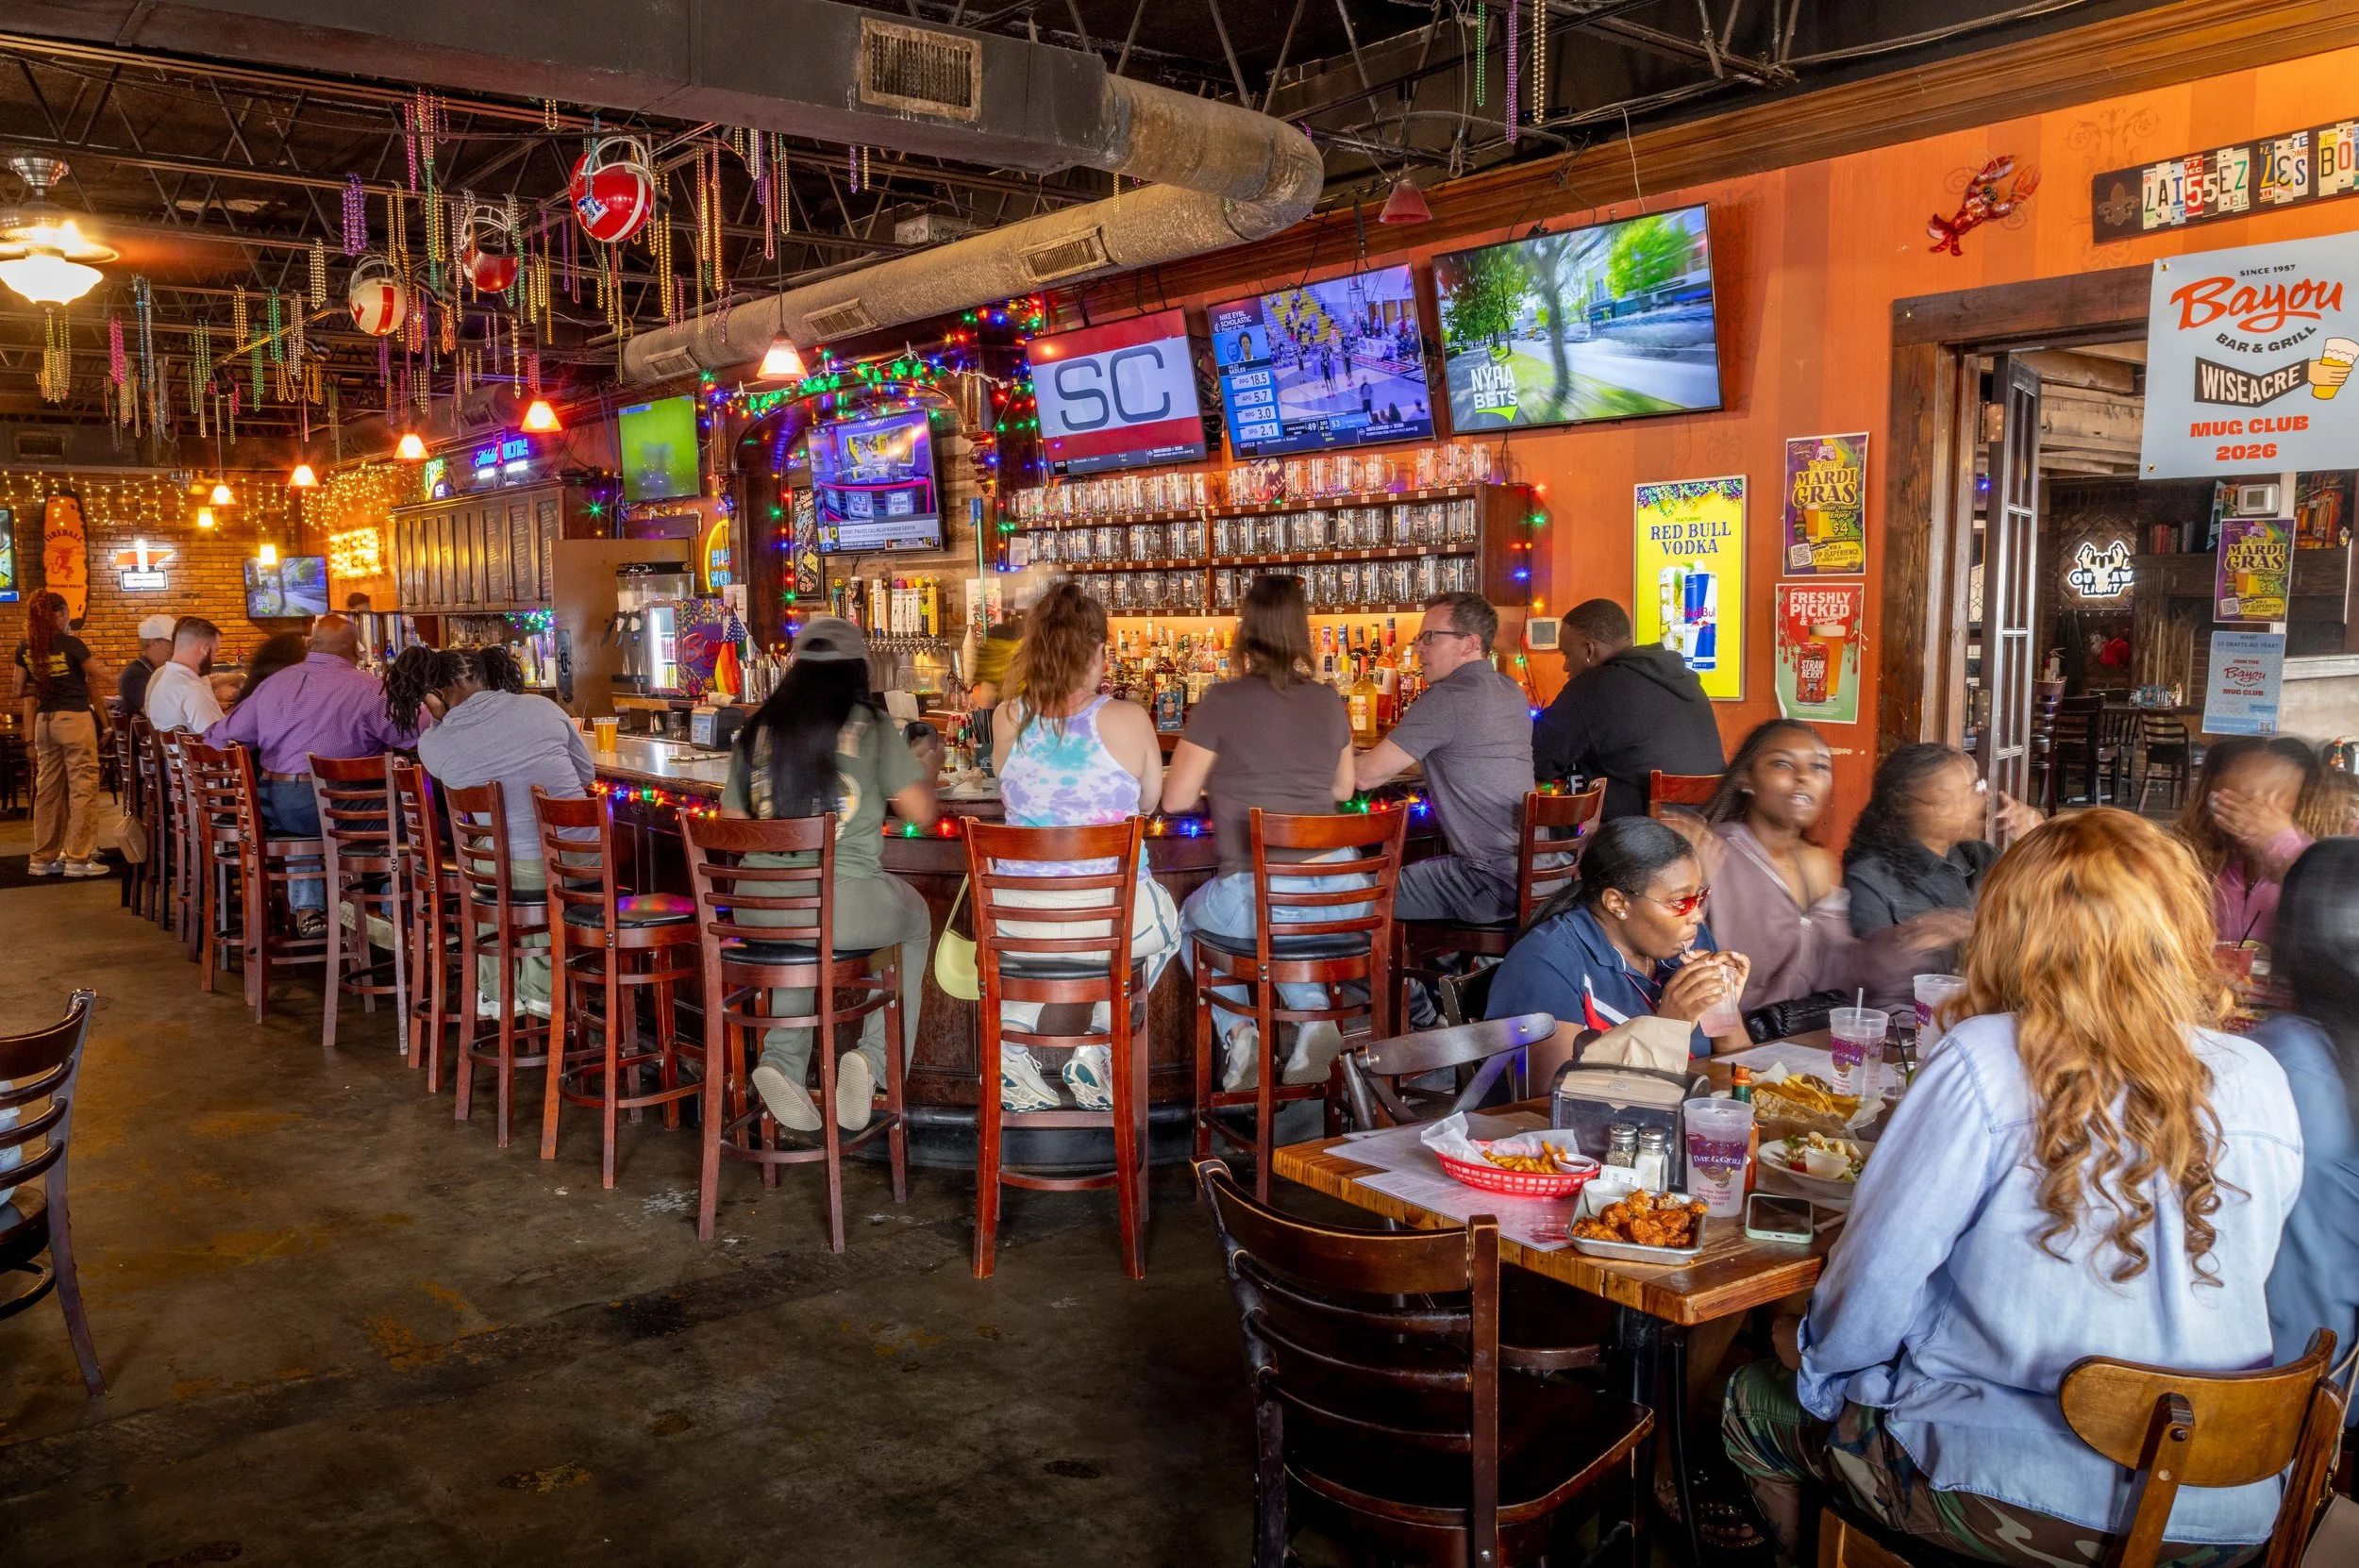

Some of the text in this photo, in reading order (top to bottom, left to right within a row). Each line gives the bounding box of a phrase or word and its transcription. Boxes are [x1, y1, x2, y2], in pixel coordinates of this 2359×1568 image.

[2240, 264, 2296, 276] SINCE 1987
[2170, 276, 2343, 333] Bayou
[1219, 310, 1233, 322] NIKE
[1221, 316, 1252, 328] SCHOLASTIC
[2216, 325, 2317, 353] BAR & GRILL
[1250, 375, 1267, 386] 18.5
[1471, 364, 1515, 392] NYRA
[2201, 363, 2301, 405] WISEACRE
[1055, 345, 1171, 431] SC
[1254, 391, 1267, 403] 5.7
[1474, 389, 1517, 409] BETS
[1257, 408, 1272, 419] 3.0
[1260, 425, 1275, 436] 2.1
[1308, 423, 1316, 431] 49
[1331, 420, 1340, 428] 53
[2190, 415, 2310, 438] MUG CLUB
[2216, 442, 2277, 461] 2026
[1796, 469, 1855, 487] MARDI
[1793, 483, 1855, 506] GRAS
[1831, 511, 1852, 519] Enjoy!
[1650, 522, 1732, 541] RED BULL
[1833, 521, 1849, 535] $4
[45, 529, 84, 543] FIREBALL
[1662, 539, 1718, 556] VODKA
[2228, 545, 2284, 555] MARDI
[2226, 555, 2284, 570] GRAS
[711, 569, 731, 588] NO
[2071, 570, 2133, 584] OUAW
[2261, 582, 2274, 592] $4
[1790, 592, 1851, 603] FRESHLY
[1790, 604, 1849, 617] PICKED
[1799, 617, 1808, 626] &
[682, 632, 724, 668] Bay
[1801, 660, 1825, 669] STRAW
[1801, 669, 1825, 679] BERRY
[2223, 666, 2266, 682] Bayou
[1720, 1156, 1741, 1165] GRILL
